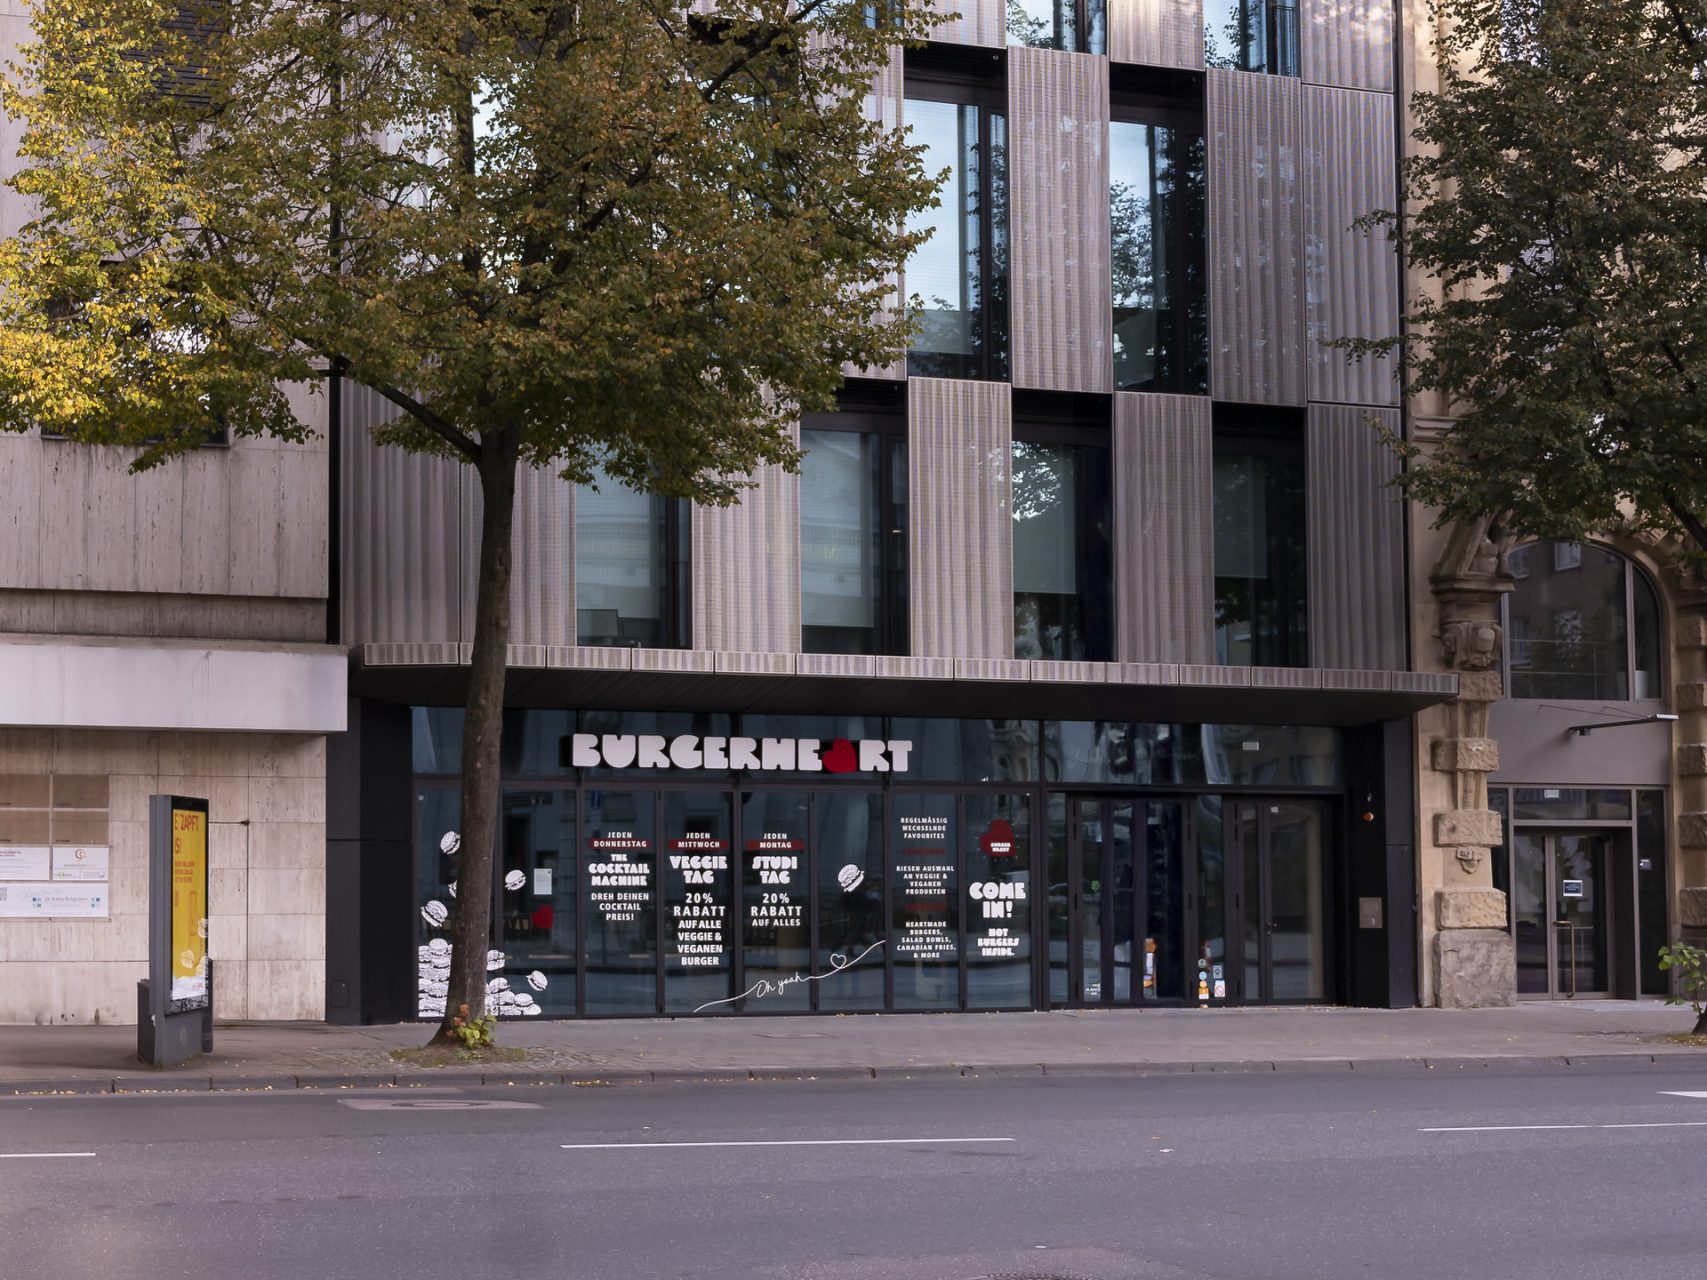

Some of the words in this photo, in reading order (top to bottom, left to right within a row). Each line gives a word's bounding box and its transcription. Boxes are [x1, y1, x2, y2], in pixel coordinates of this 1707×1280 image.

[900, 816, 948, 824] REGELMÄSSIG
[669, 856, 728, 869] VEGGIE
[752, 856, 798, 869] STUDI
[588, 863, 650, 874] COCKTAIL
[591, 876, 648, 886] MACHINE
[683, 871, 714, 884] TAG
[760, 871, 790, 884] TAG
[591, 892, 614, 900] DREH
[617, 892, 649, 900] DEINEN
[970, 882, 1026, 900] COME
[685, 893, 713, 904] 20%
[762, 893, 790, 904] 20%
[599, 903, 641, 911] COCKTAIL
[673, 906, 726, 917] RABATT
[750, 906, 802, 917] RABATT
[982, 900, 1013, 918] IN!
[606, 913, 634, 921] PREIS!
[752, 918, 770, 926] AUF
[773, 918, 801, 926] ALLES
[678, 920, 697, 929] AUF
[698, 920, 722, 929] ALLE
[678, 932, 713, 941] VEGGIE
[715, 932, 722, 941] &
[988, 928, 1008, 937] HOT
[978, 938, 1020, 946] BURGERS
[677, 944, 723, 953] VEGANEN
[982, 948, 1015, 956] INSIDE.
[681, 956, 720, 966] BURGER
[756, 980, 776, 998] Oh
[778, 972, 803, 995] yeah
